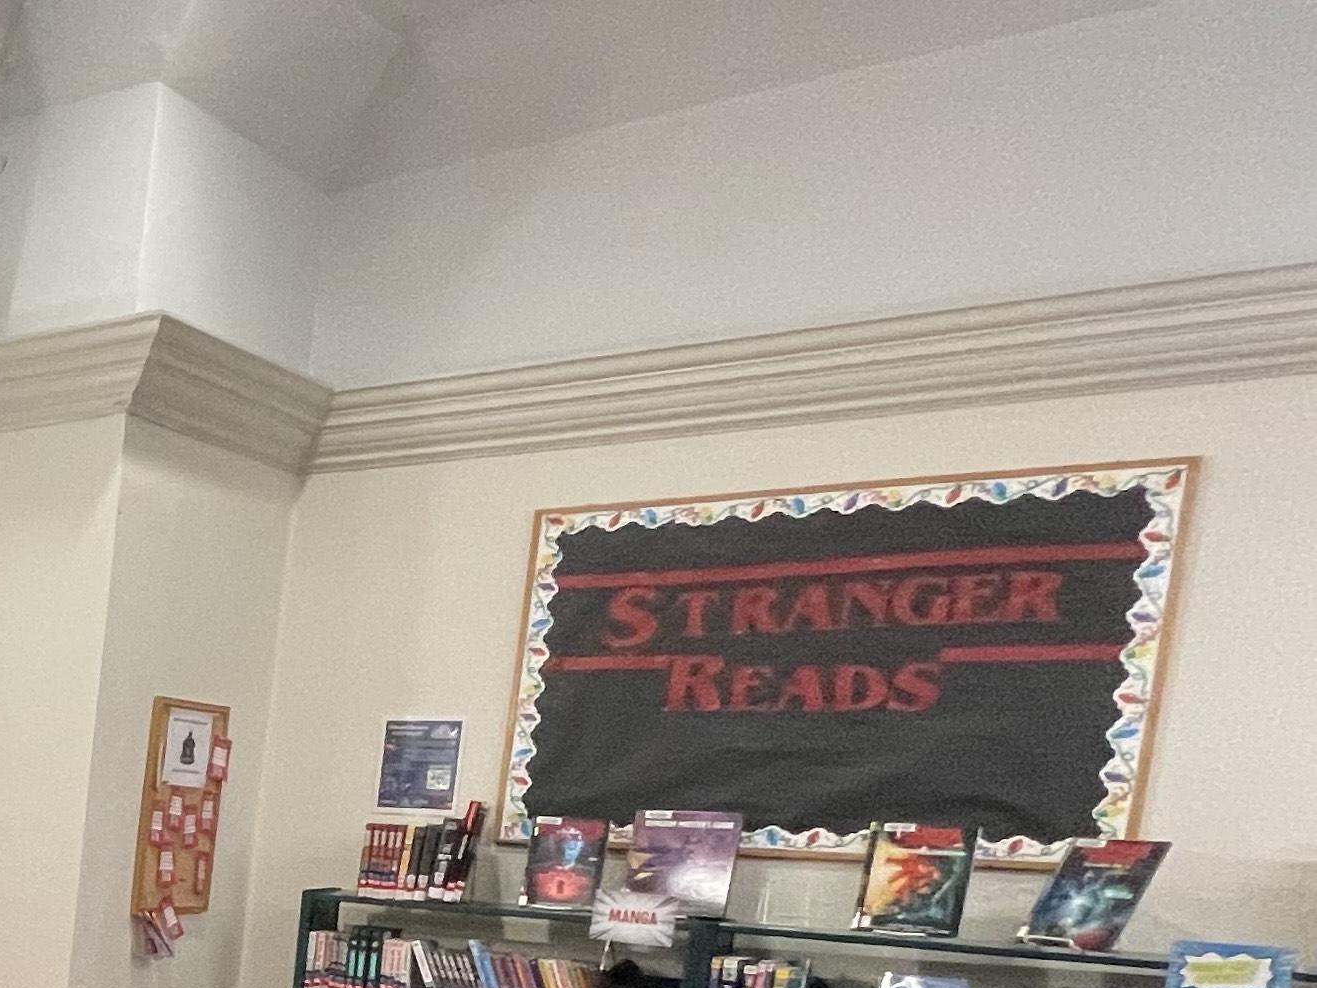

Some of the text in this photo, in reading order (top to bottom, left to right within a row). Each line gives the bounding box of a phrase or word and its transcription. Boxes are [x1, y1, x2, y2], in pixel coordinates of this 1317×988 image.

[604, 572, 1064, 649] STRANGER
[664, 653, 943, 713] READS
[608, 908, 657, 925] MANGA
